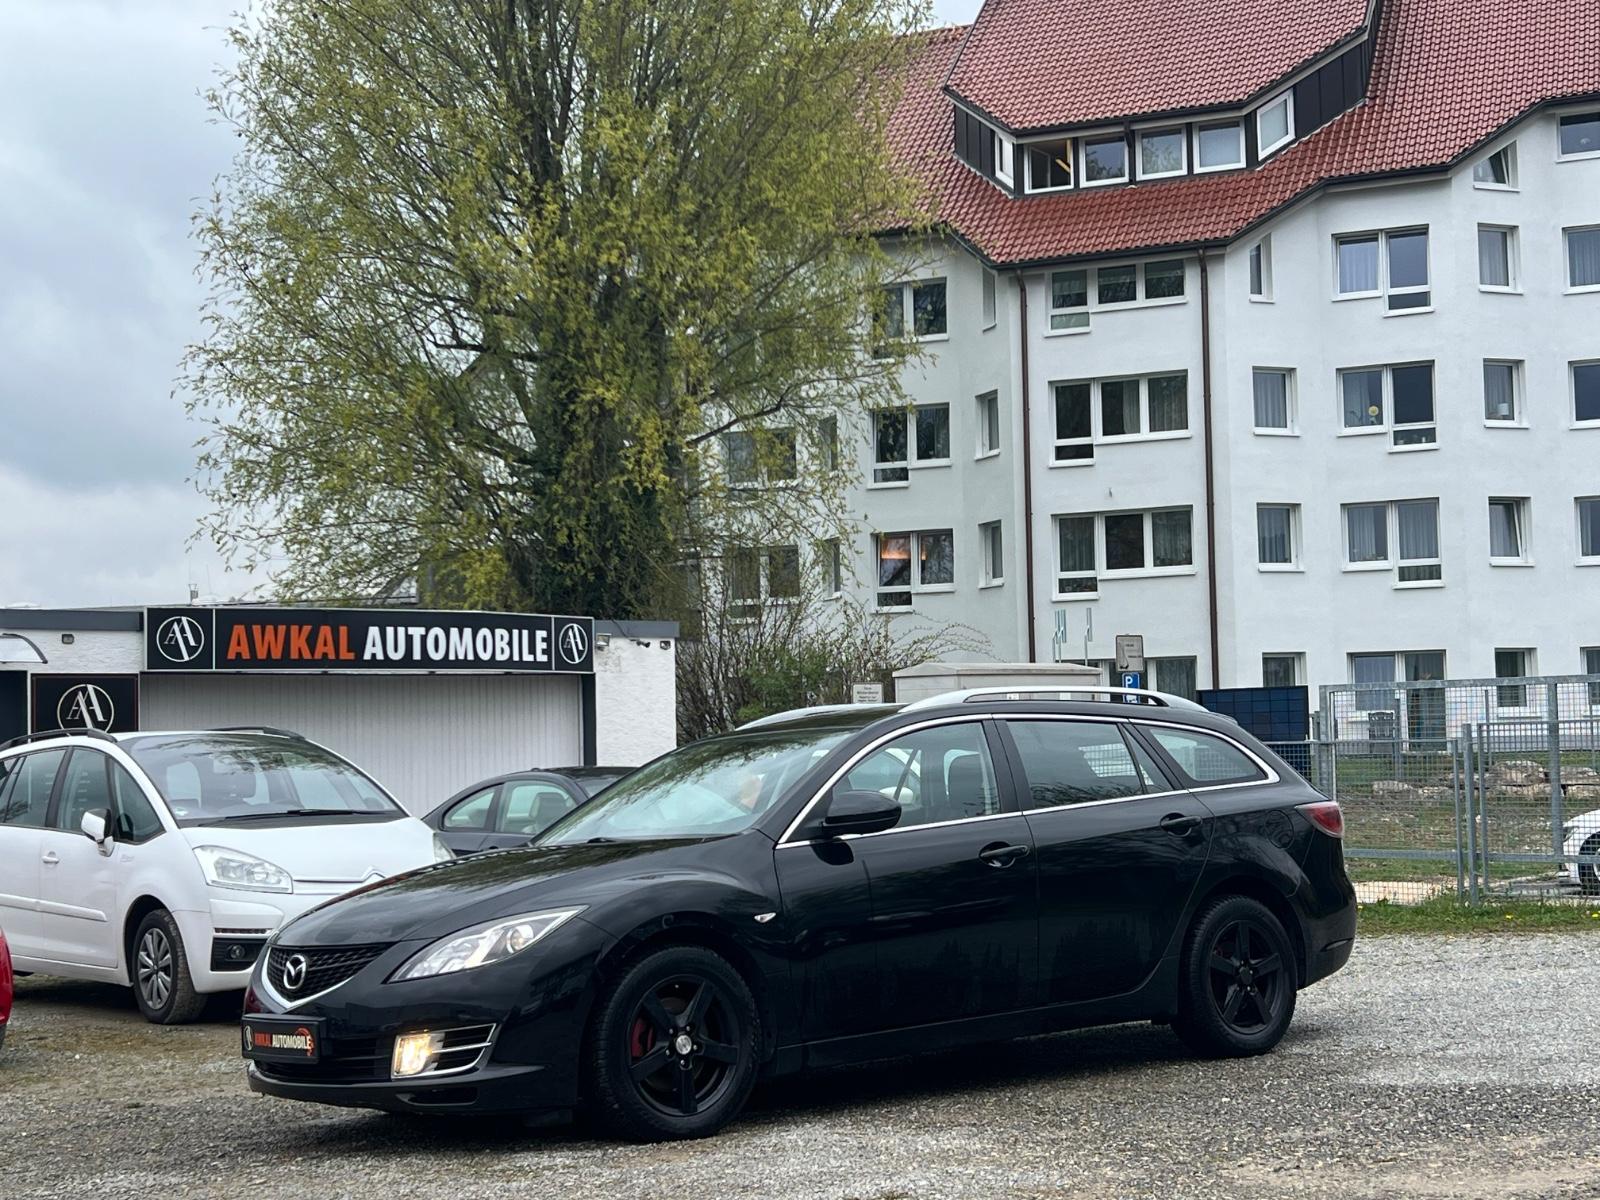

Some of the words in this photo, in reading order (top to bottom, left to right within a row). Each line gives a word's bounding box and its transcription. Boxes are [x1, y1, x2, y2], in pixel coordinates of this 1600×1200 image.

[226, 624, 355, 660] AWKAL
[363, 626, 548, 662] AUTOMOBILE
[1125, 676, 1133, 688] P
[272, 1034, 313, 1050] AUTOMOBILE
